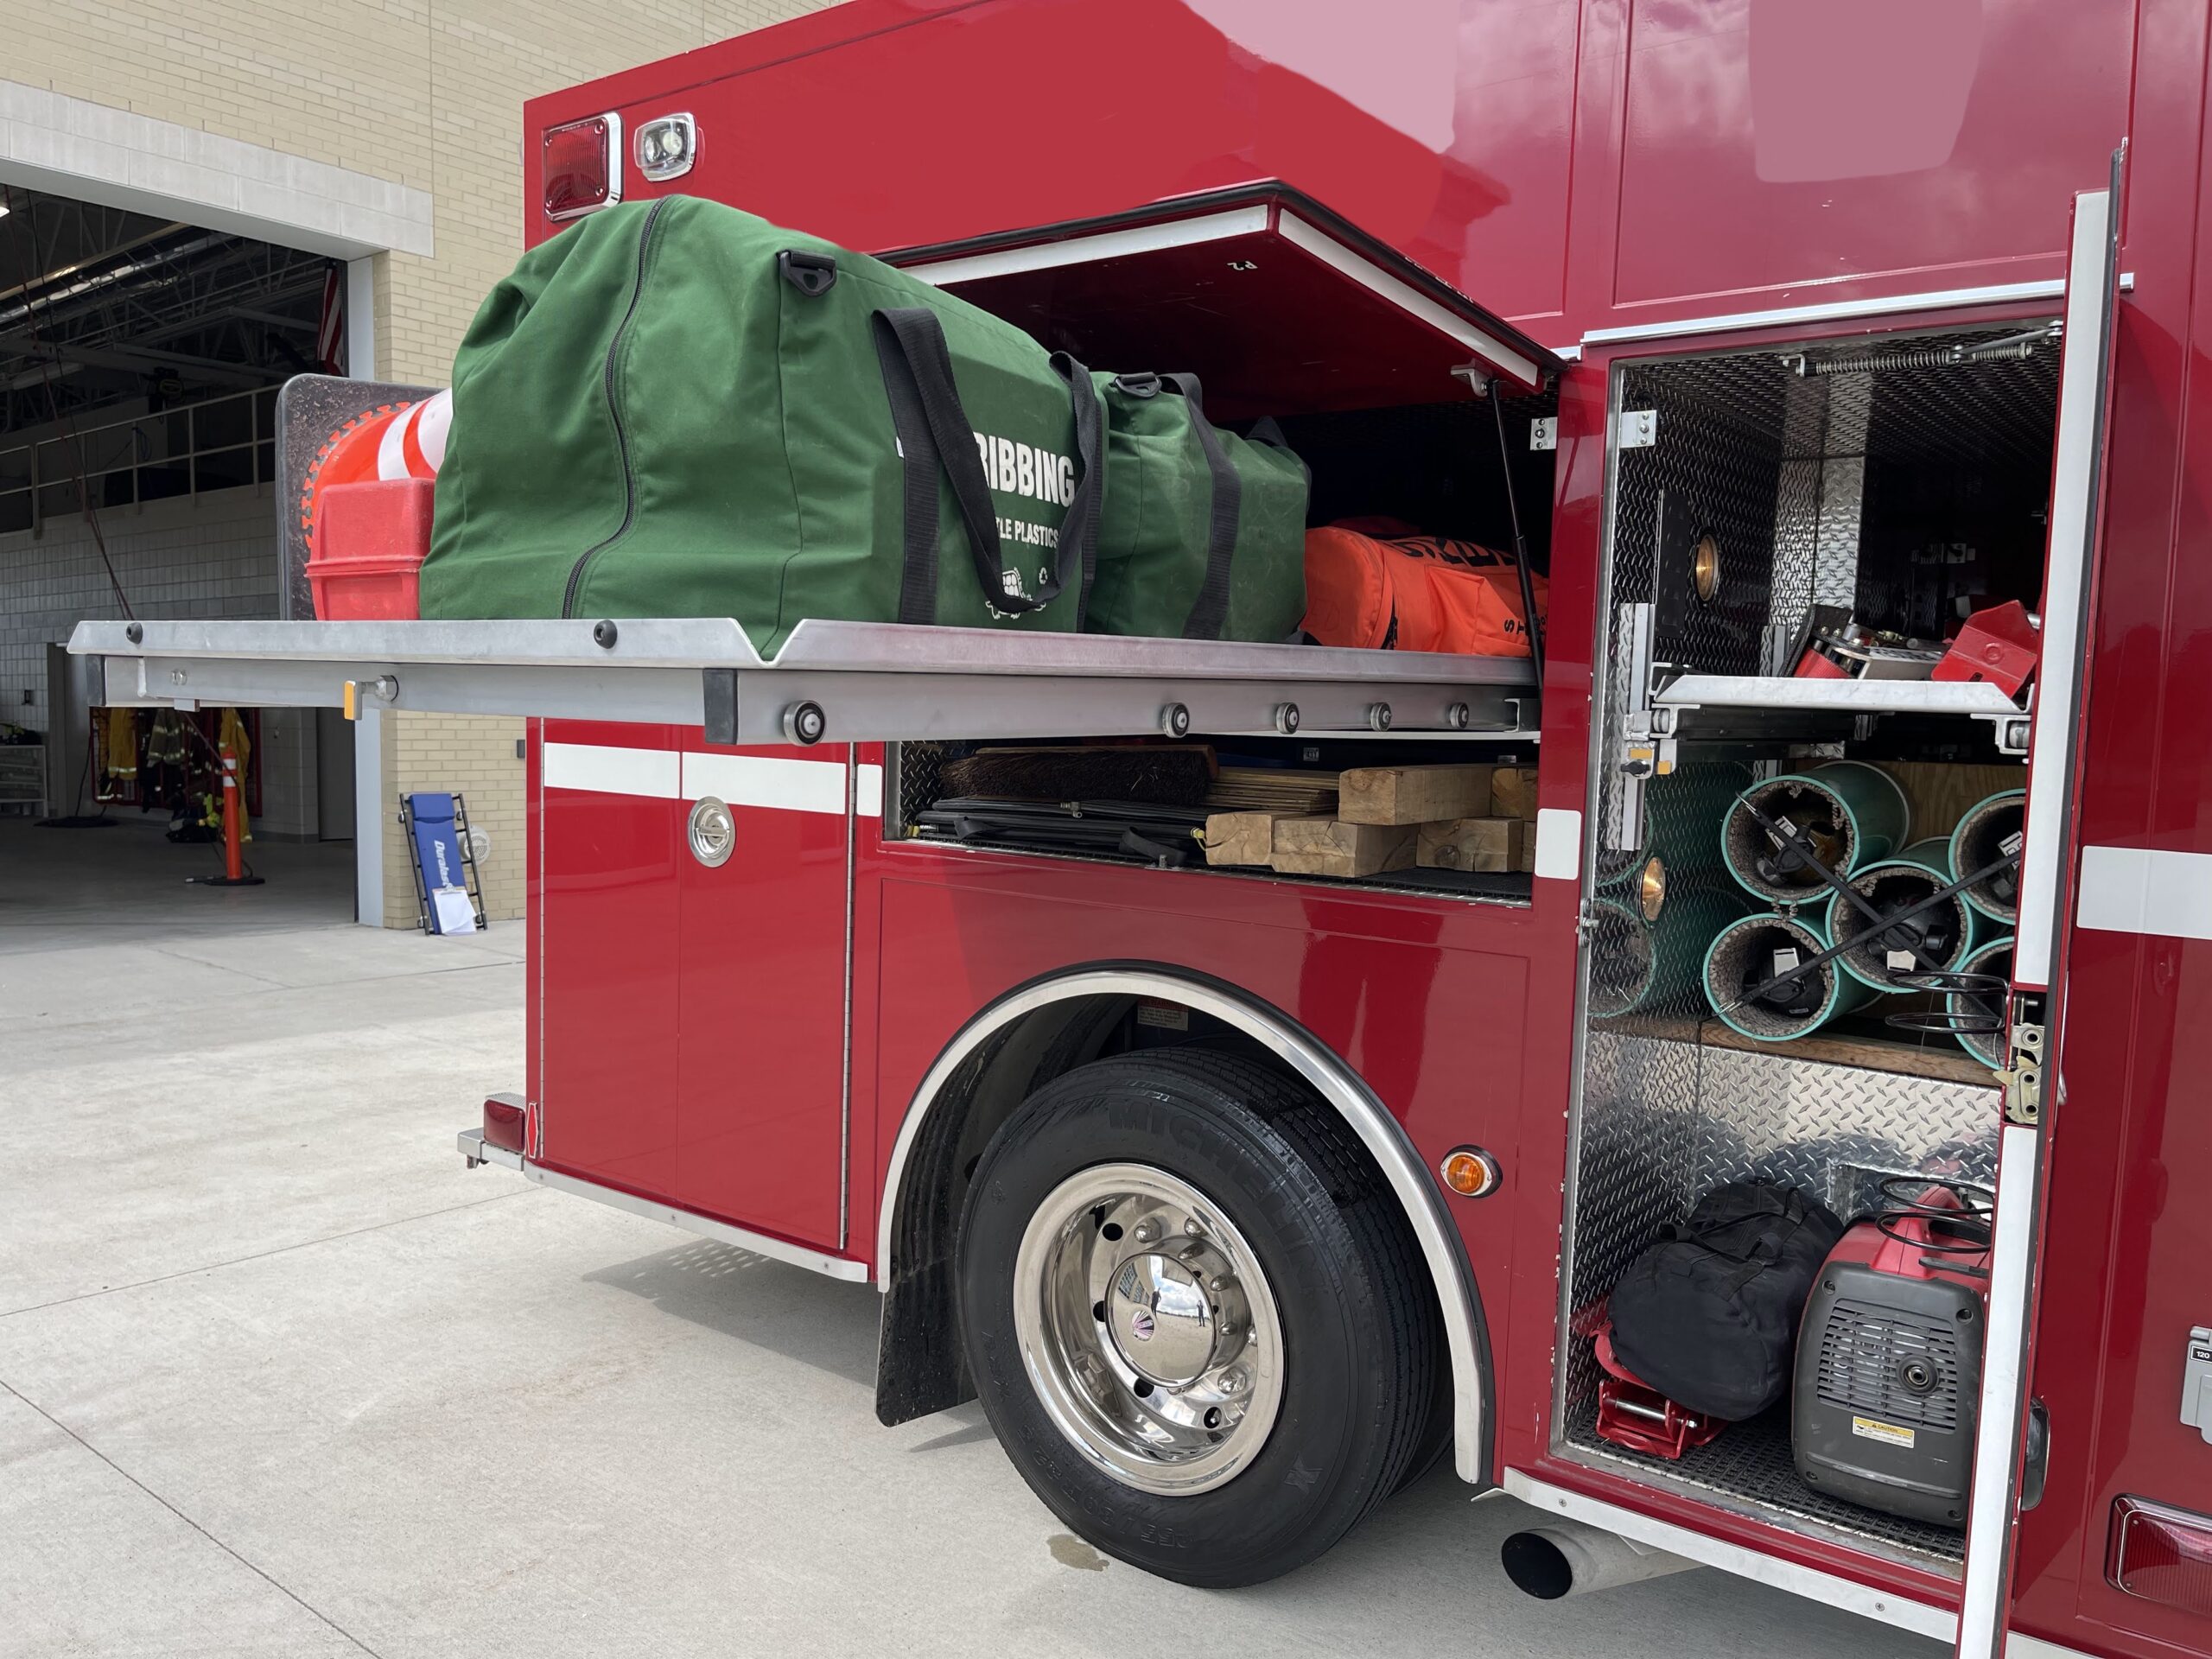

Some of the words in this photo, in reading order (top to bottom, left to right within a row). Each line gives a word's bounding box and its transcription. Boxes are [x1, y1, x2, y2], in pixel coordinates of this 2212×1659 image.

[973, 431, 1076, 508] RIBBING
[1014, 520, 1059, 549] PLASTICS
[1109, 1098, 1327, 1288] MICHELIN
[2196, 1351, 2210, 1359] 120
